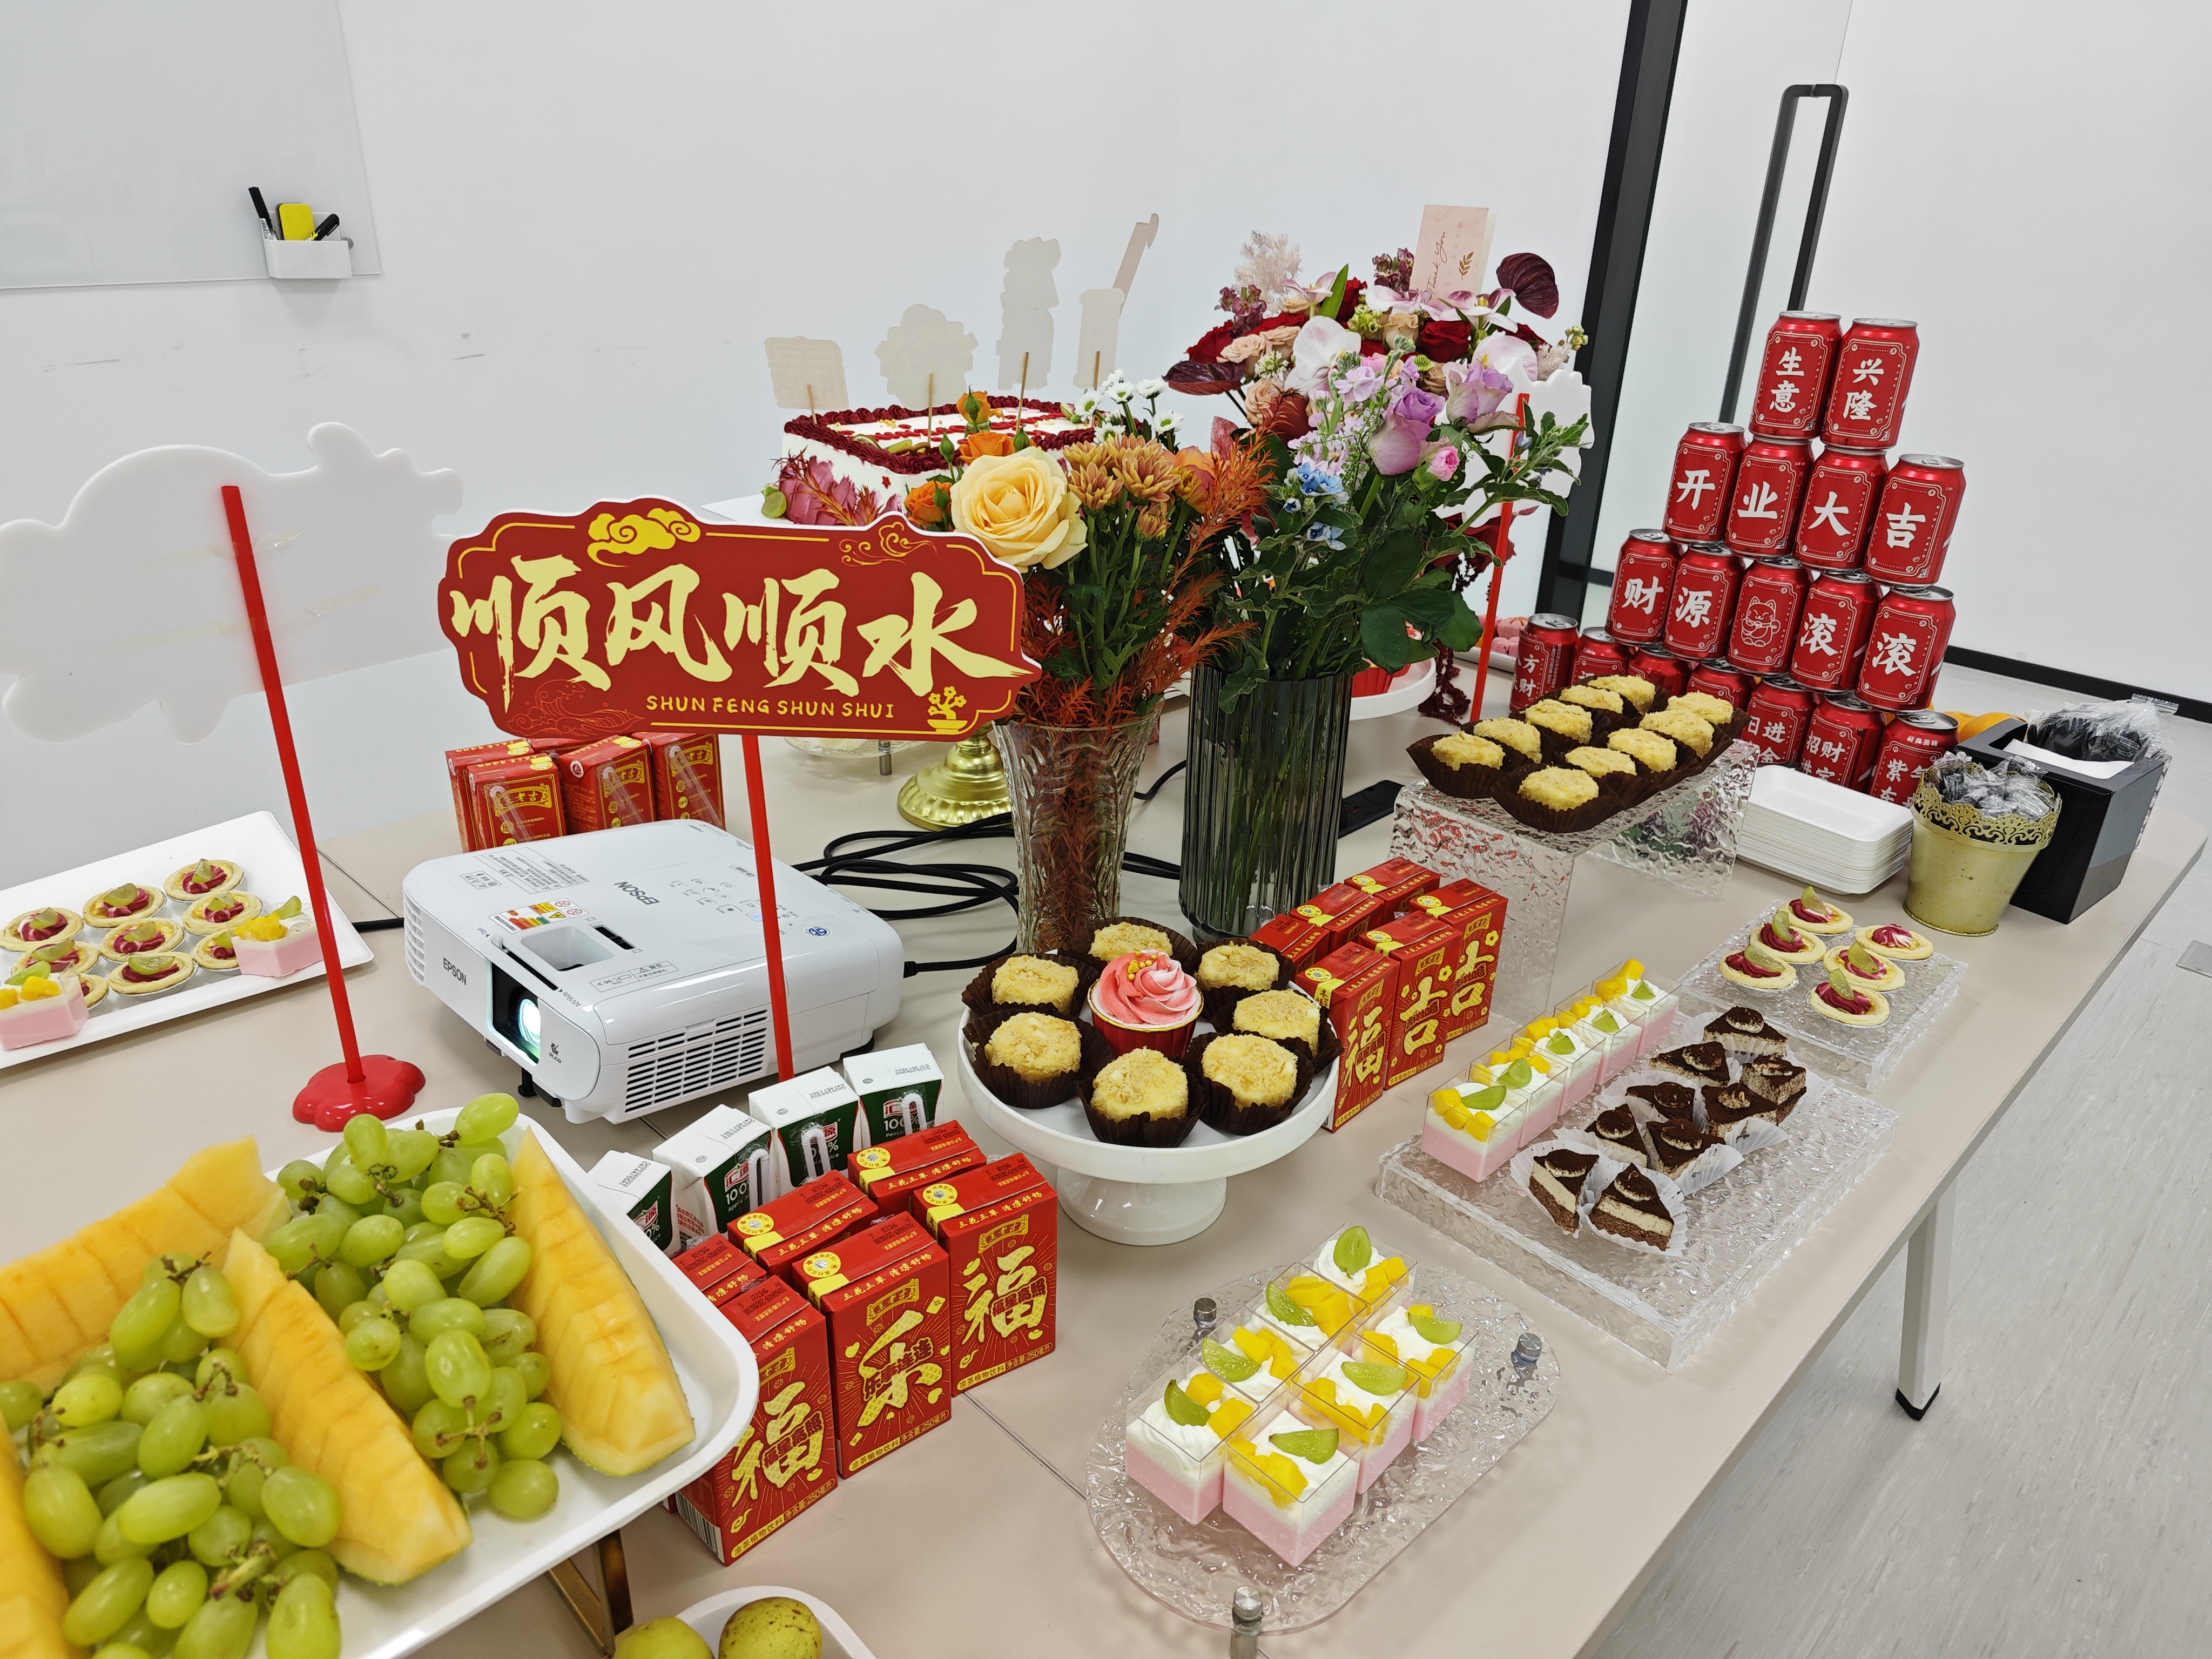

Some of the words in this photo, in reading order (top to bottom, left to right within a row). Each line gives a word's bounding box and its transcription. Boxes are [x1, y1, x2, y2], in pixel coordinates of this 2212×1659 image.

[1434, 231, 1447, 264] You
[1770, 346, 1805, 413] 生意
[1843, 358, 1884, 421] 兴隆
[1676, 469, 1716, 511] 开
[1737, 481, 1778, 520] 业
[1808, 491, 1851, 536] 大
[1886, 502, 1926, 549] 吉
[1621, 576, 1664, 615] 财
[1675, 586, 1712, 628] 源
[450, 554, 1042, 713] 顺风顺水
[1800, 612, 1839, 656] 滚
[1872, 632, 1918, 677] 滚
[646, 695, 705, 712] SHUN
[712, 697, 770, 714] FENG
[777, 700, 835, 717] SHUN
[842, 702, 894, 718] SHUI
[1806, 731, 1846, 763] 招财
[1906, 736, 1938, 747] 经典美味
[614, 881, 660, 905] EPSON
[443, 957, 467, 986] EPSON
[549, 1051, 562, 1064] 3LCD
[886, 1130, 903, 1138] Peach
[888, 1172, 928, 1190] 三花三草
[932, 1157, 972, 1175] 清凉舒畅
[725, 1181, 748, 1205] 100
[727, 1198, 743, 1213] Apple
[959, 1209, 999, 1229] 三花三草
[1002, 1191, 1042, 1212] 清凉舒畅
[779, 1232, 819, 1256] 三花三草
[822, 1207, 863, 1232] 清凉舒畅
[990, 1223, 1018, 1240] 王老吉
[844, 1276, 886, 1301] 三花三草
[889, 1253, 932, 1277] 清凉舒畅
[962, 1246, 1046, 1345] 福
[878, 1290, 907, 1310] 王老吉
[993, 1280, 1046, 1317] 福星高照
[762, 1319, 807, 1350] 清凉舒畅
[960, 1364, 1004, 1388] 凉茶植物饮料
[732, 1381, 822, 1507] 福
[765, 1413, 822, 1467] 福星高照
[852, 1440, 899, 1469] 凉茶植物饮料
[734, 1516, 783, 1556] 凉茶植物饮料
